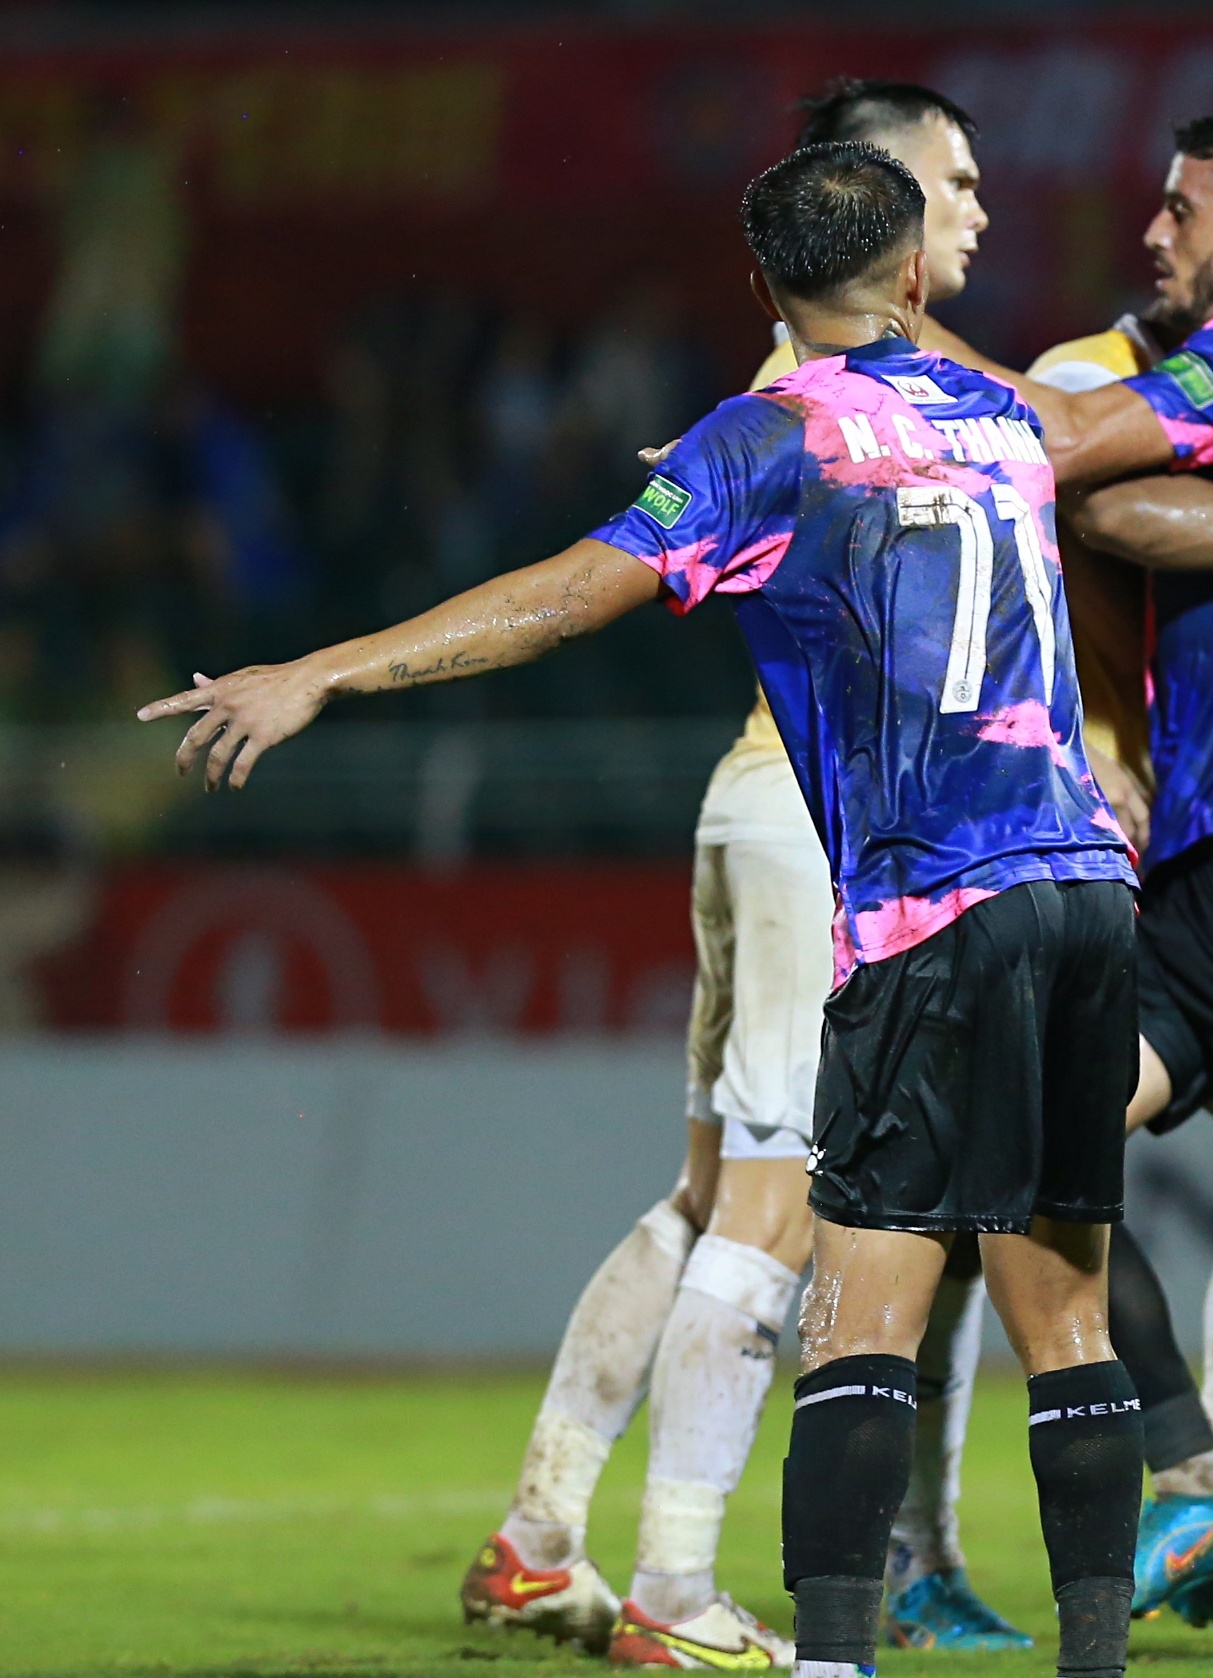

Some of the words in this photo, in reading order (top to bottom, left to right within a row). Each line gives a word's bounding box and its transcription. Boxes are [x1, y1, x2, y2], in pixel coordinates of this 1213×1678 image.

[837, 413, 892, 464] N.
[891, 413, 934, 461] C.
[930, 415, 1050, 466] THANH
[641, 485, 680, 516] WOLF
[896, 473, 1056, 715] 77
